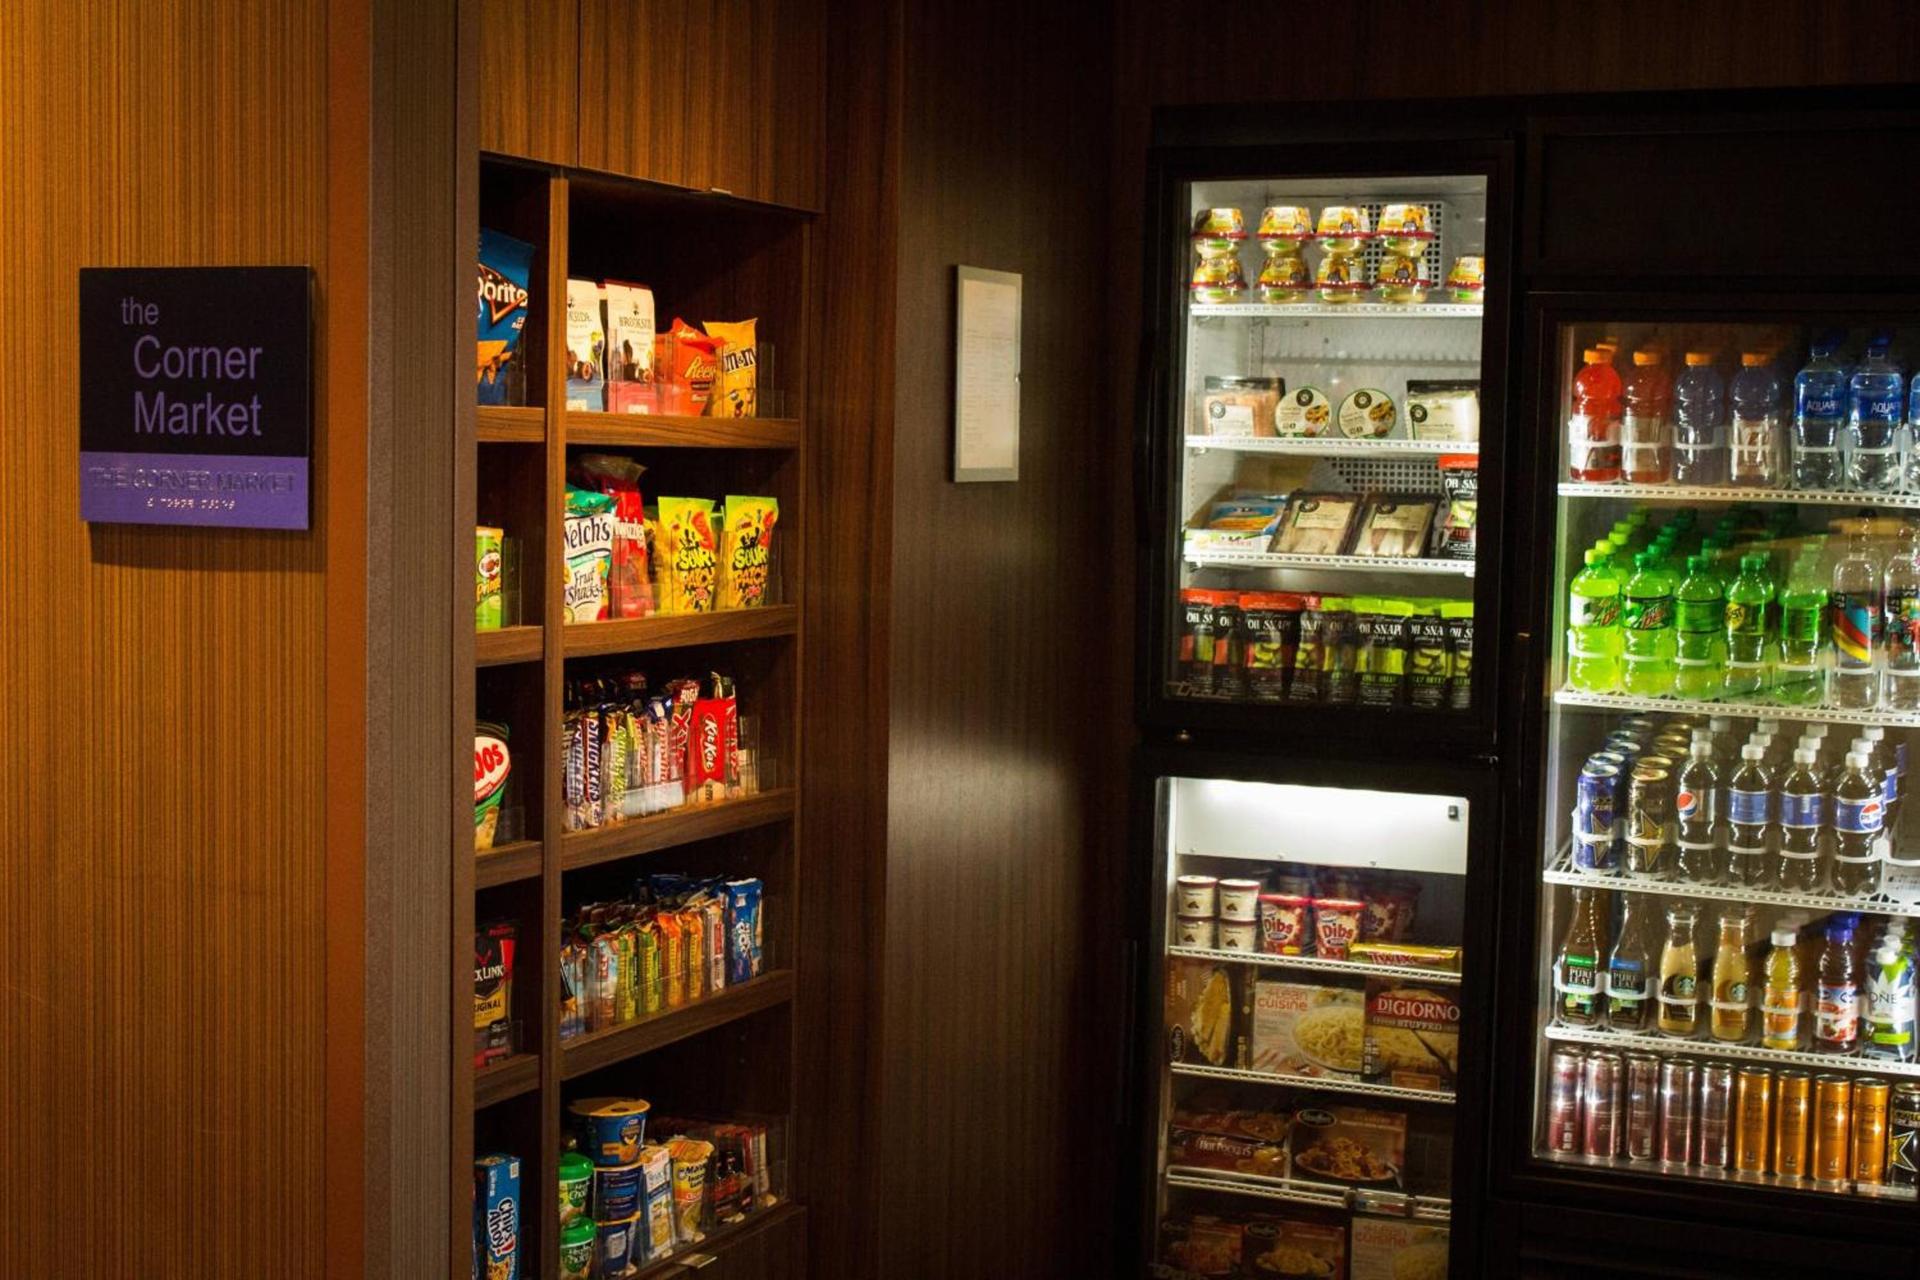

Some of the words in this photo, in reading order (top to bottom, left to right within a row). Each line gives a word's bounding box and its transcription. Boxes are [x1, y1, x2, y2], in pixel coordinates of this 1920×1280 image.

[121, 297, 159, 325] the
[133, 335, 263, 380] Corner
[134, 391, 262, 436] Market
[88, 467, 128, 487] THE
[133, 468, 210, 490] CORNER
[217, 471, 297, 492] MARKET
[1263, 917, 1294, 934] Dibs
[1322, 922, 1353, 939] Dibs
[1376, 998, 1460, 1021] DIGIORNO
[500, 1198, 515, 1243] Chips
